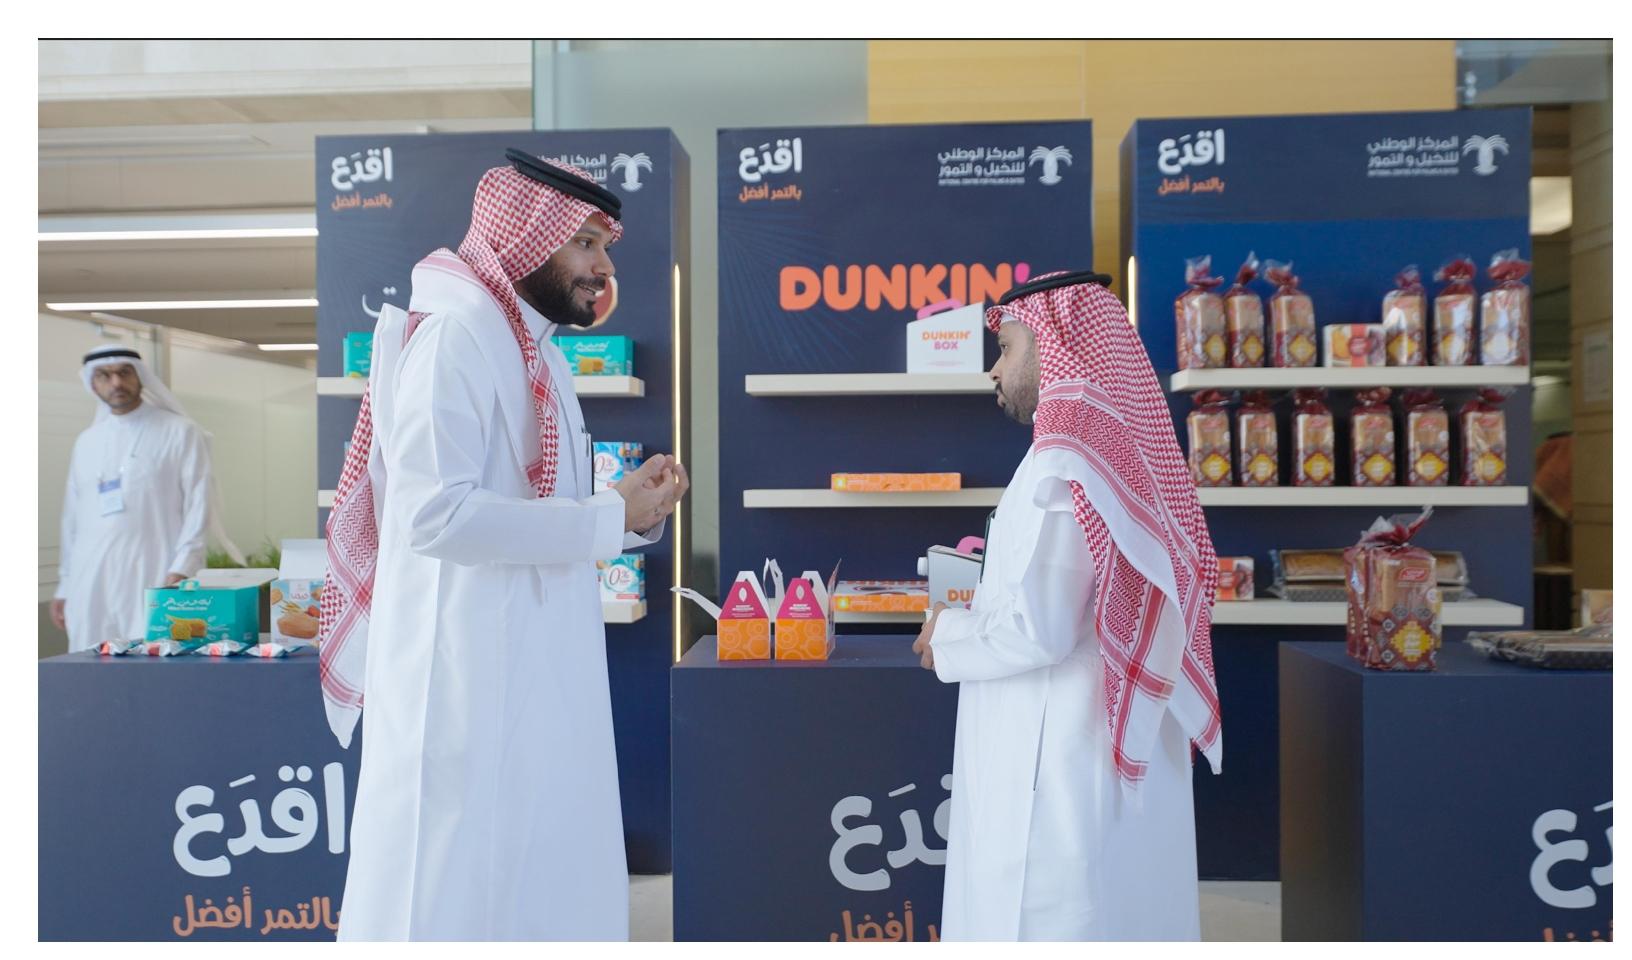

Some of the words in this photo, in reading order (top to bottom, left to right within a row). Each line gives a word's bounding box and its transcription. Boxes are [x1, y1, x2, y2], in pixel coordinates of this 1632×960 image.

[779, 262, 1030, 311] DUNKIN'
[934, 341, 958, 350] BOX
[173, 886, 252, 937] أفضل
